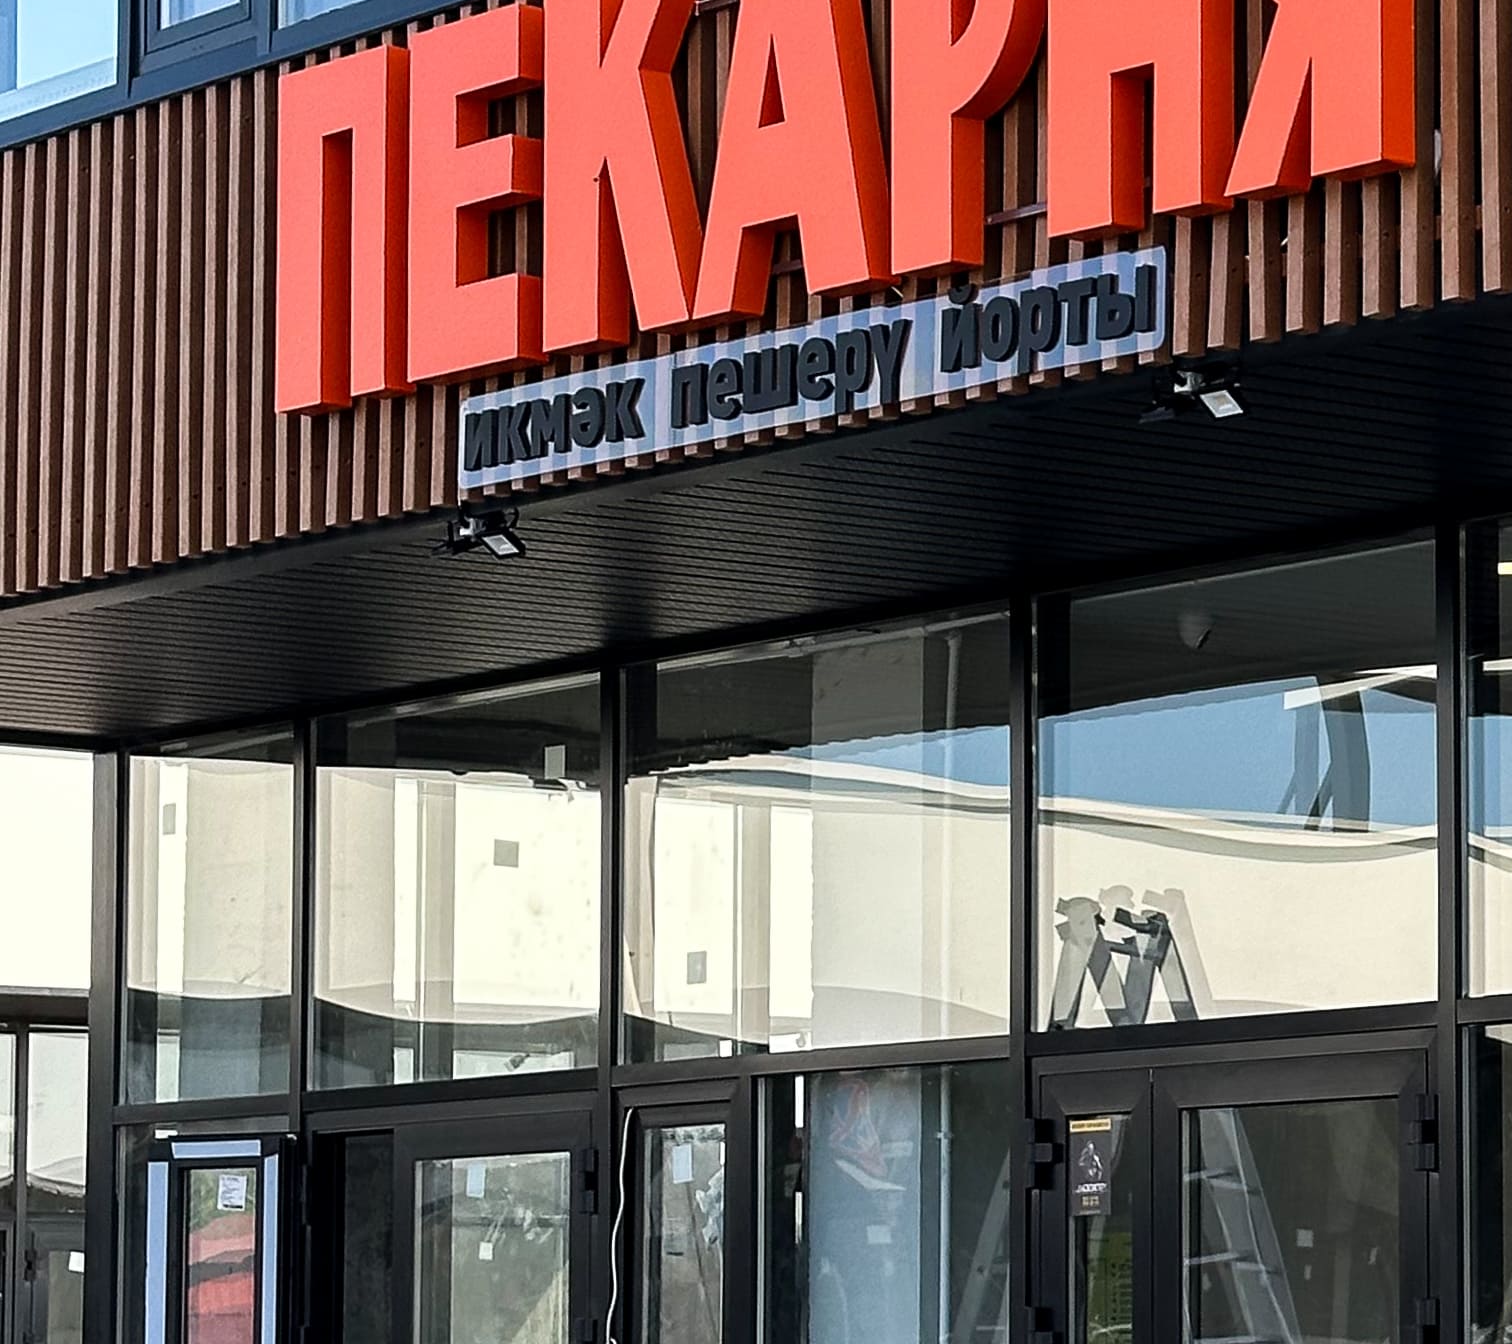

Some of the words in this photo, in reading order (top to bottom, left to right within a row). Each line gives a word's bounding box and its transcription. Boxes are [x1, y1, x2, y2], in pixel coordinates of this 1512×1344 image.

[463, 376, 646, 472] икмәк
[671, 318, 913, 430] пешерү
[940, 262, 1159, 375] йорты
